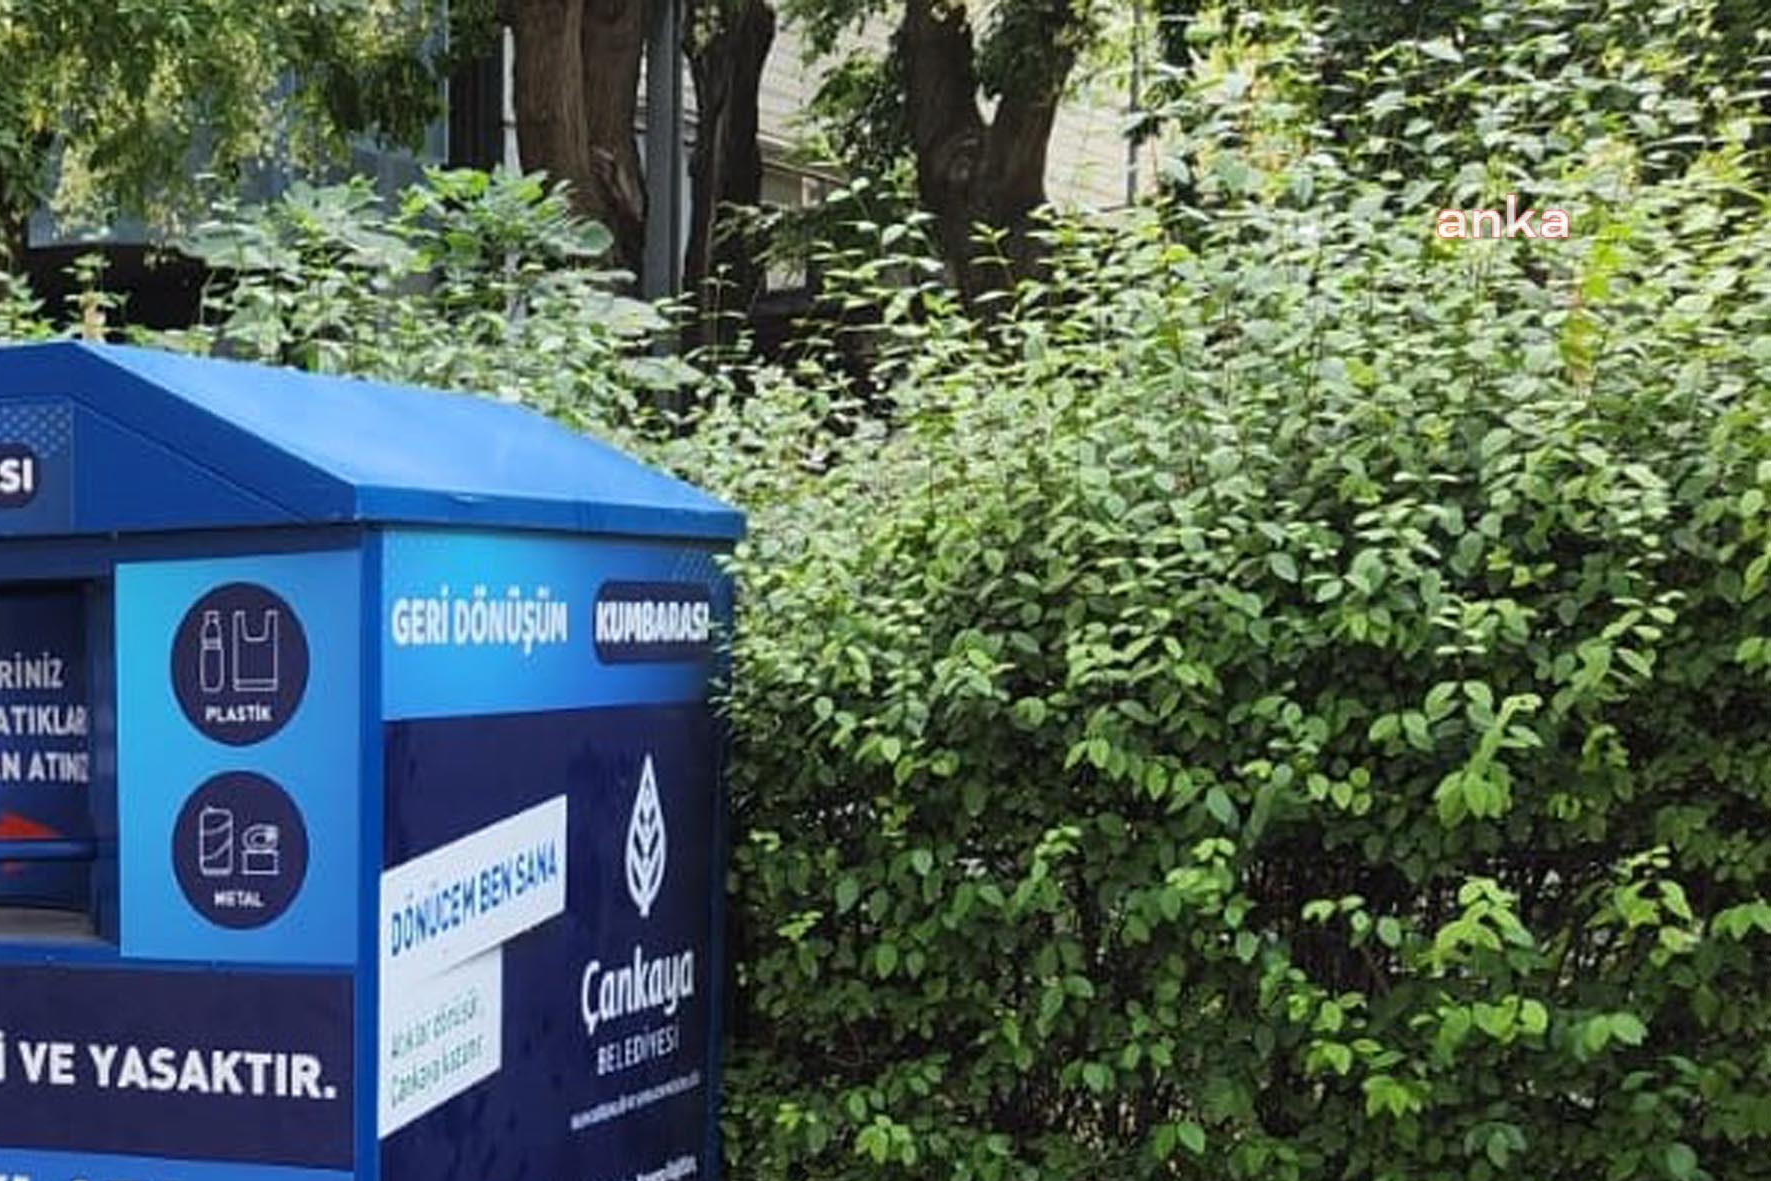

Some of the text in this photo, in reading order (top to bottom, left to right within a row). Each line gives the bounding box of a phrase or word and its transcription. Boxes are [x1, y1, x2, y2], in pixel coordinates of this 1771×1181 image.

[391, 584, 711, 656] GERİ DÖNÜŞÜM KUMBARASI
[205, 703, 274, 723] PLASTİK
[213, 891, 265, 909] METAL
[391, 839, 557, 957] DÖNÜCEM BEN SANA
[581, 945, 695, 1037] Çankaya
[18, 1041, 76, 1085] VE
[88, 1044, 338, 1100] YASAKTIR.
[597, 1021, 681, 1077] BELEDİYESİ
